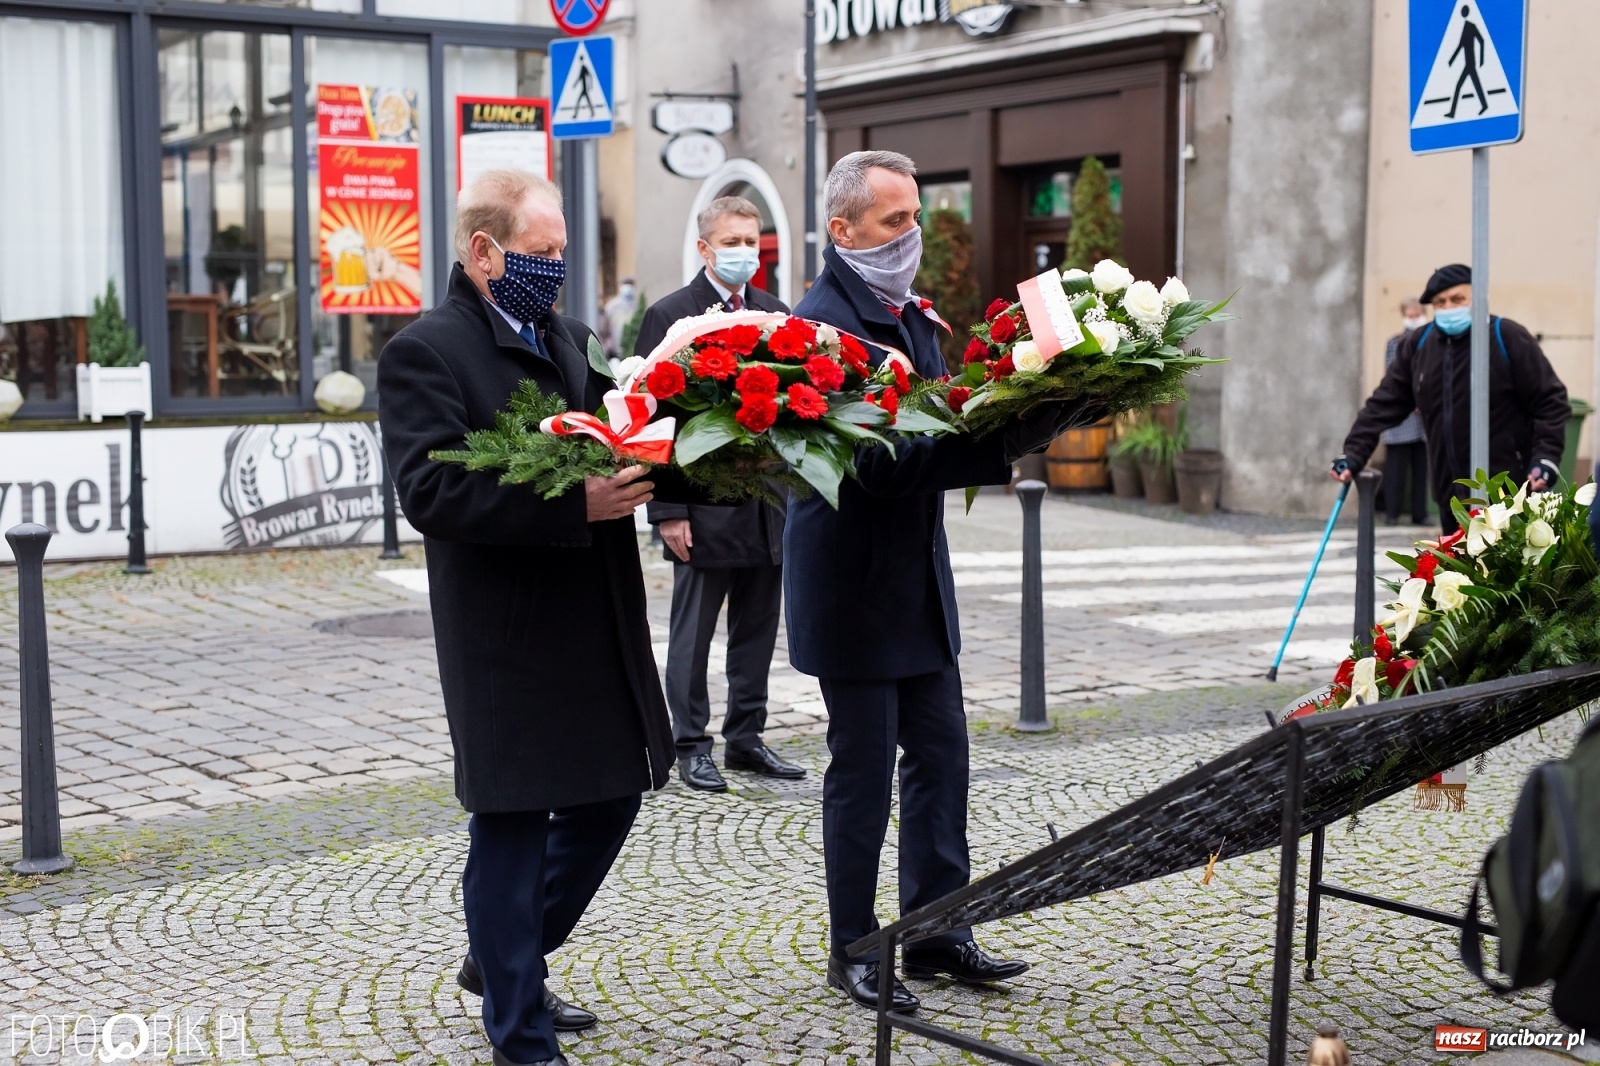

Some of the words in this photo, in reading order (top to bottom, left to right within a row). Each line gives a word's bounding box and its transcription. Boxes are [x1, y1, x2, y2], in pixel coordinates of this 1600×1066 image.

[473, 103, 536, 123] LUNCH
[343, 174, 368, 187] DWA
[369, 175, 397, 187] PIWA
[325, 186, 338, 198] W
[338, 186, 367, 199] CENIE
[369, 187, 414, 200] JEDNEGO
[0, 443, 149, 534] nek
[240, 505, 318, 547] Browar
[320, 486, 385, 525] Rynek
